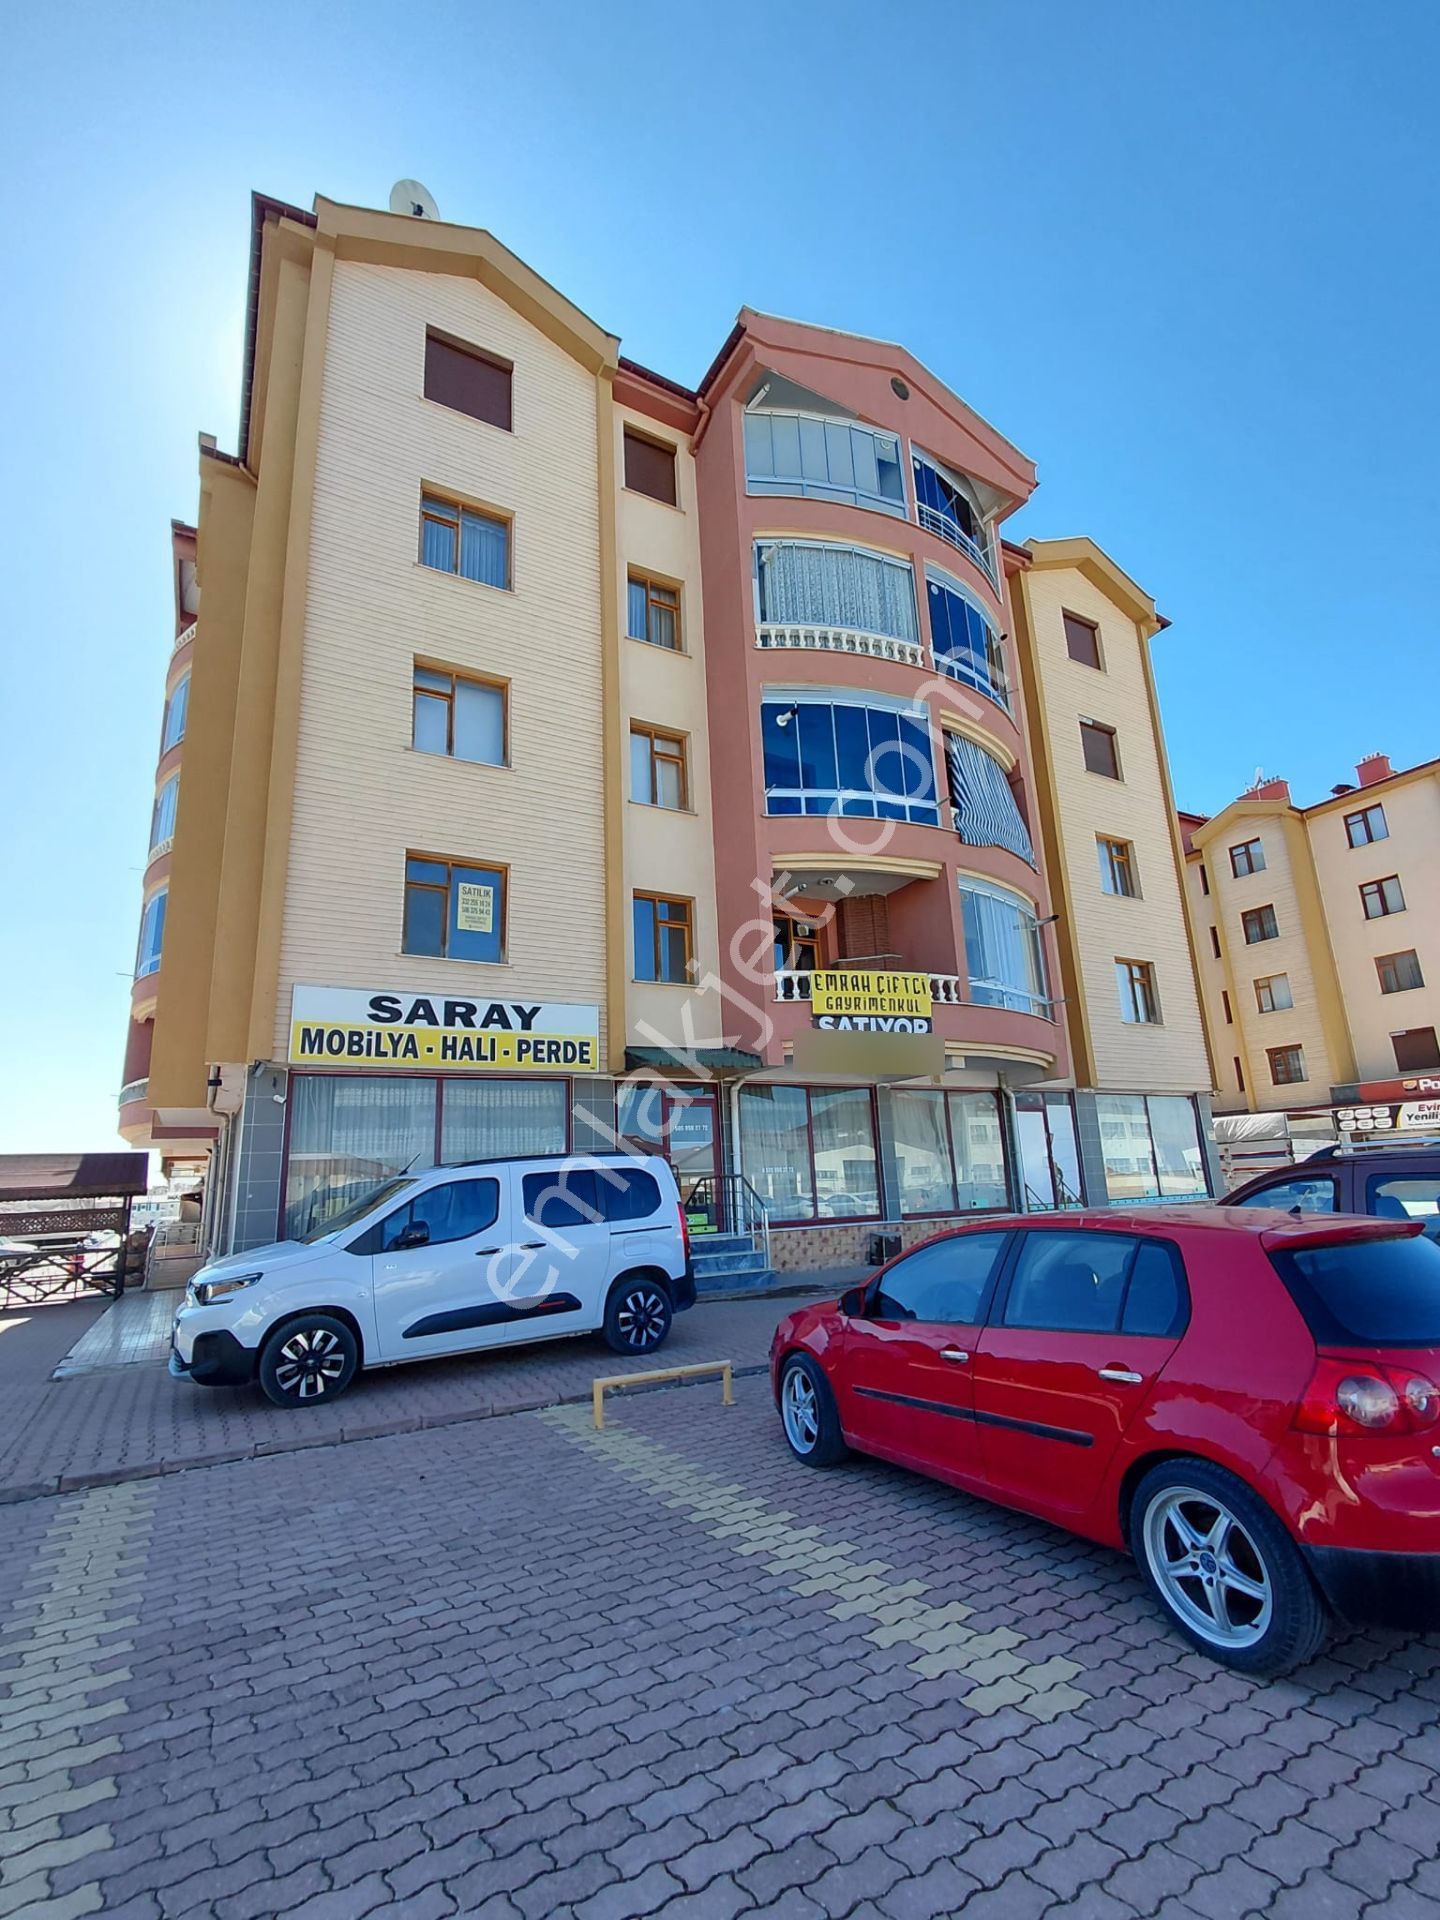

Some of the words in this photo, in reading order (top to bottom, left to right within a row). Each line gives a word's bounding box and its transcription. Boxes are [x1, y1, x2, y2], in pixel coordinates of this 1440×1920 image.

[462, 886, 491, 898] SATILIK
[814, 973, 871, 993] EMRAH
[366, 995, 542, 1031] SARAY
[441, 1035, 496, 1062] HALI
[517, 1039, 592, 1065] PERDE
[1406, 1111, 1440, 1121] Yenili
